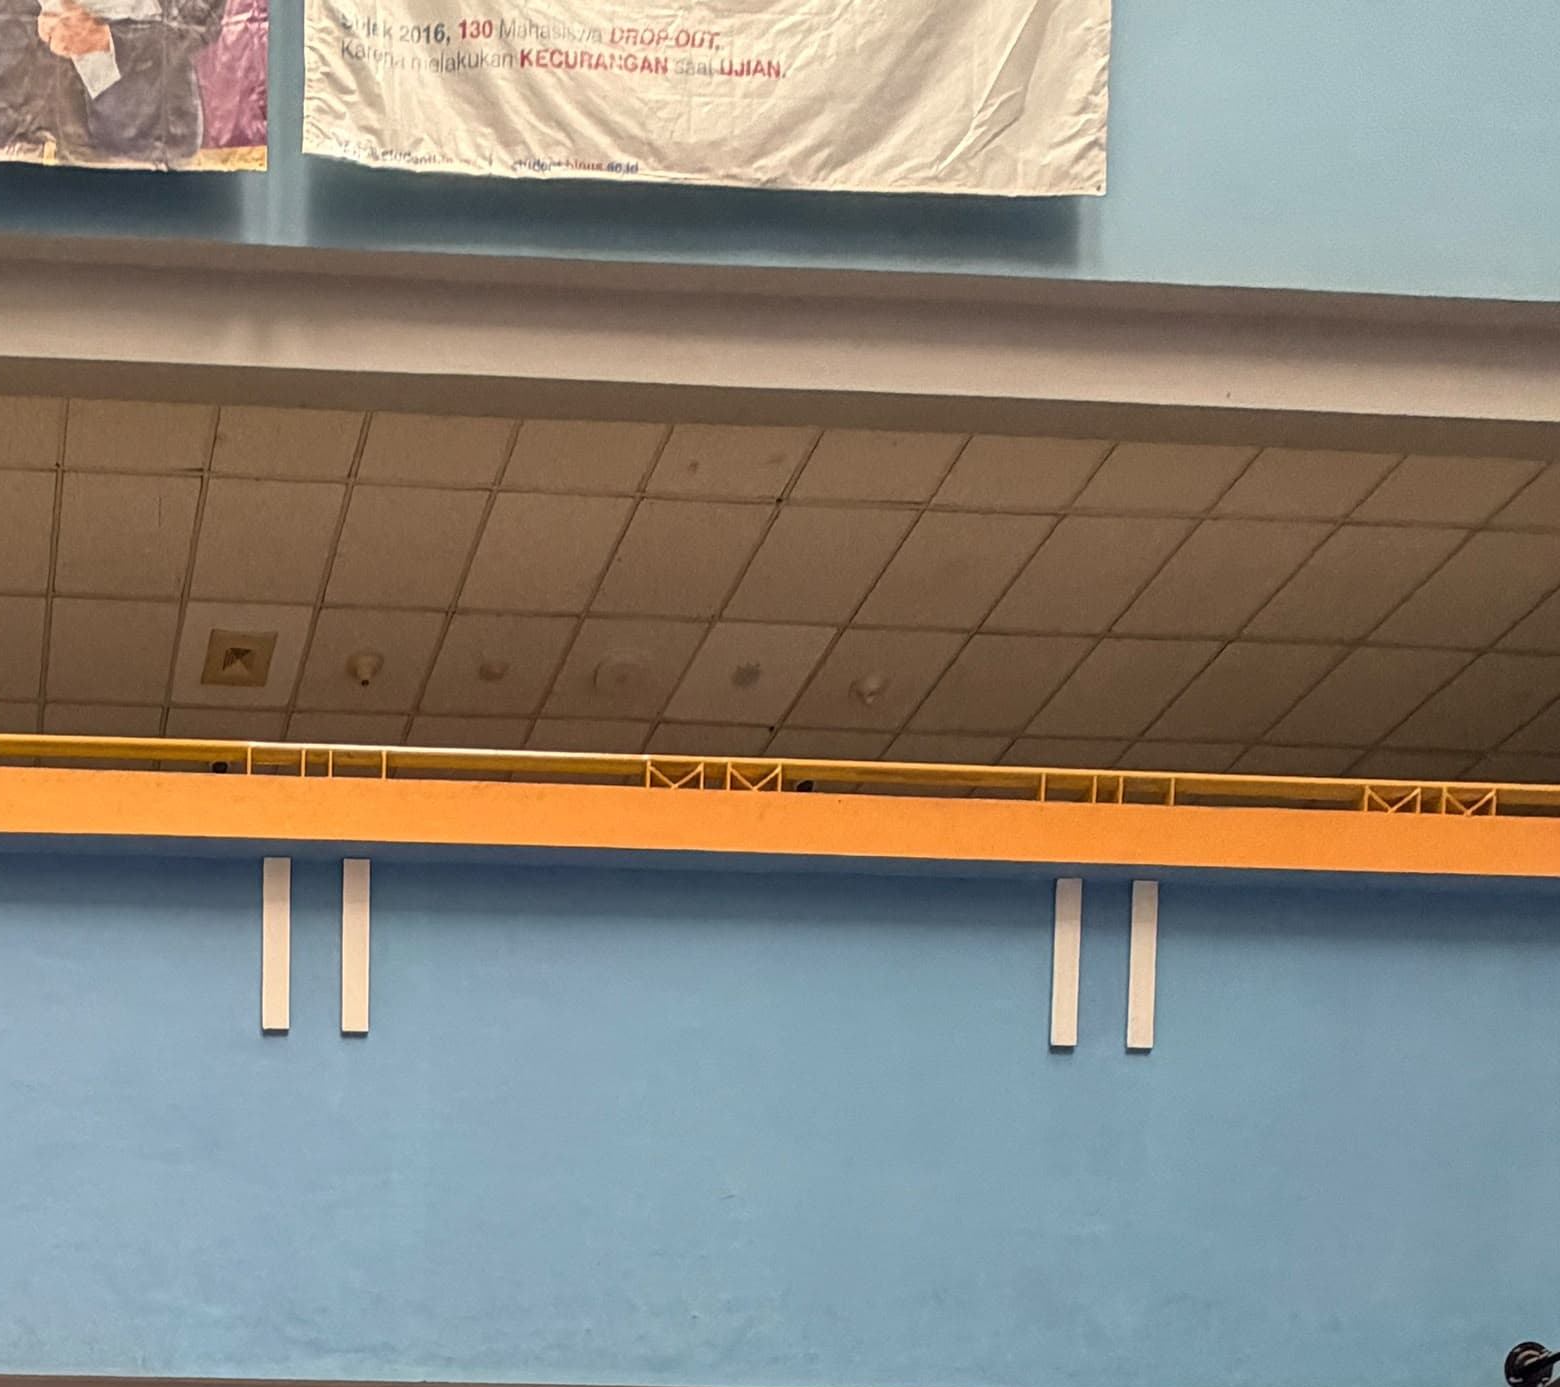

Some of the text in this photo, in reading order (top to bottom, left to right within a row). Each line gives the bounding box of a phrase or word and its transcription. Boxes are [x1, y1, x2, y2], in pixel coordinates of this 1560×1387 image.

[399, 24, 451, 45] 2016,
[459, 18, 494, 39] 130
[520, 48, 669, 75] KECURANGAN
